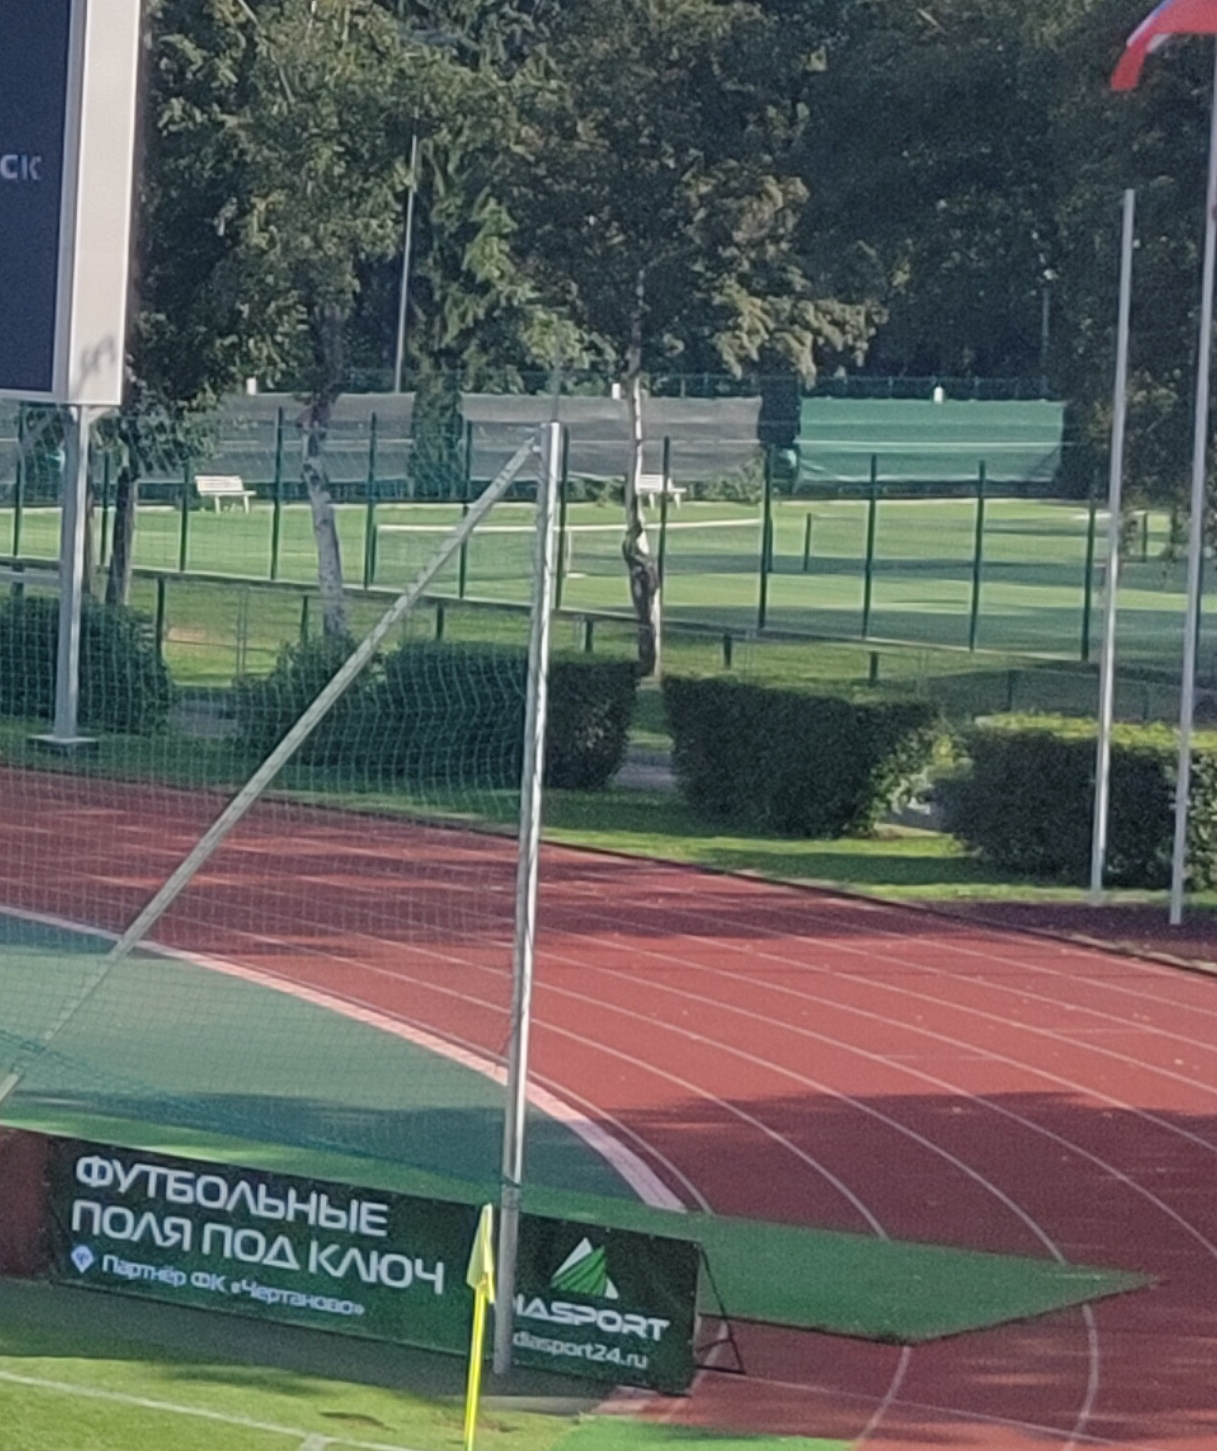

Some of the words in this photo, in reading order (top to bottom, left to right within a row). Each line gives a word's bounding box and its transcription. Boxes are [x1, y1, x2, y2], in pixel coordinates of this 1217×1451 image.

[75, 1155, 389, 1237] ФУТБОЛЬНЫЕ
[72, 1200, 192, 1251] ПОЛЯ
[202, 1223, 300, 1270] ПОД
[308, 1239, 444, 1295] КЛЮЧ
[190, 1271, 228, 1292] ФК
[513, 1293, 671, 1342] IASPORT
[513, 1330, 647, 1369] diasport24.ru
